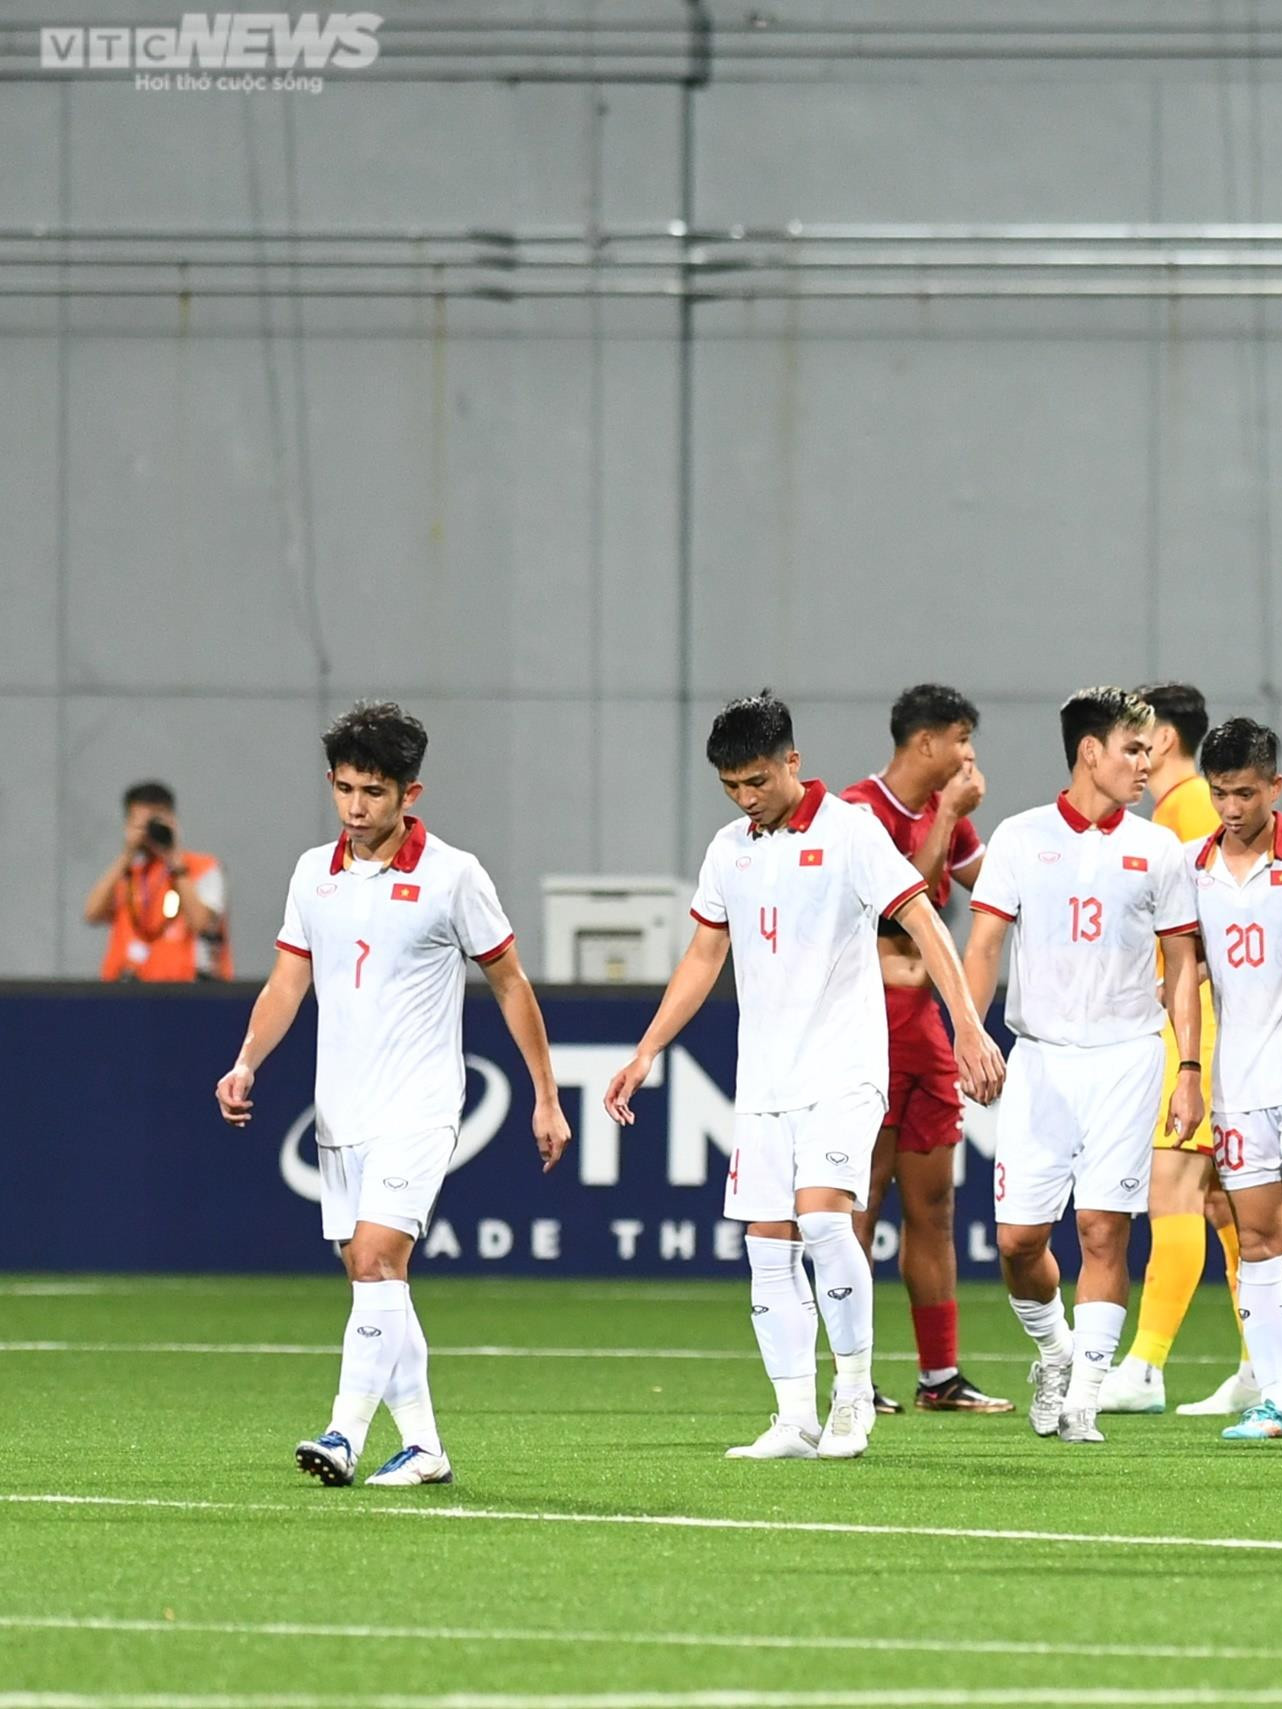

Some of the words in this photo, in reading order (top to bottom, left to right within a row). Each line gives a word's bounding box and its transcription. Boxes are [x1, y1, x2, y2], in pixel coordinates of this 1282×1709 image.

[759, 906, 778, 954] 4
[1068, 896, 1103, 942] 13
[355, 938, 371, 989] 7
[1225, 922, 1265, 968] 20
[1213, 1124, 1245, 1171] 20
[996, 1161, 1006, 1202] 3
[334, 1218, 561, 1260] ADE
[610, 1218, 744, 1261] THE
